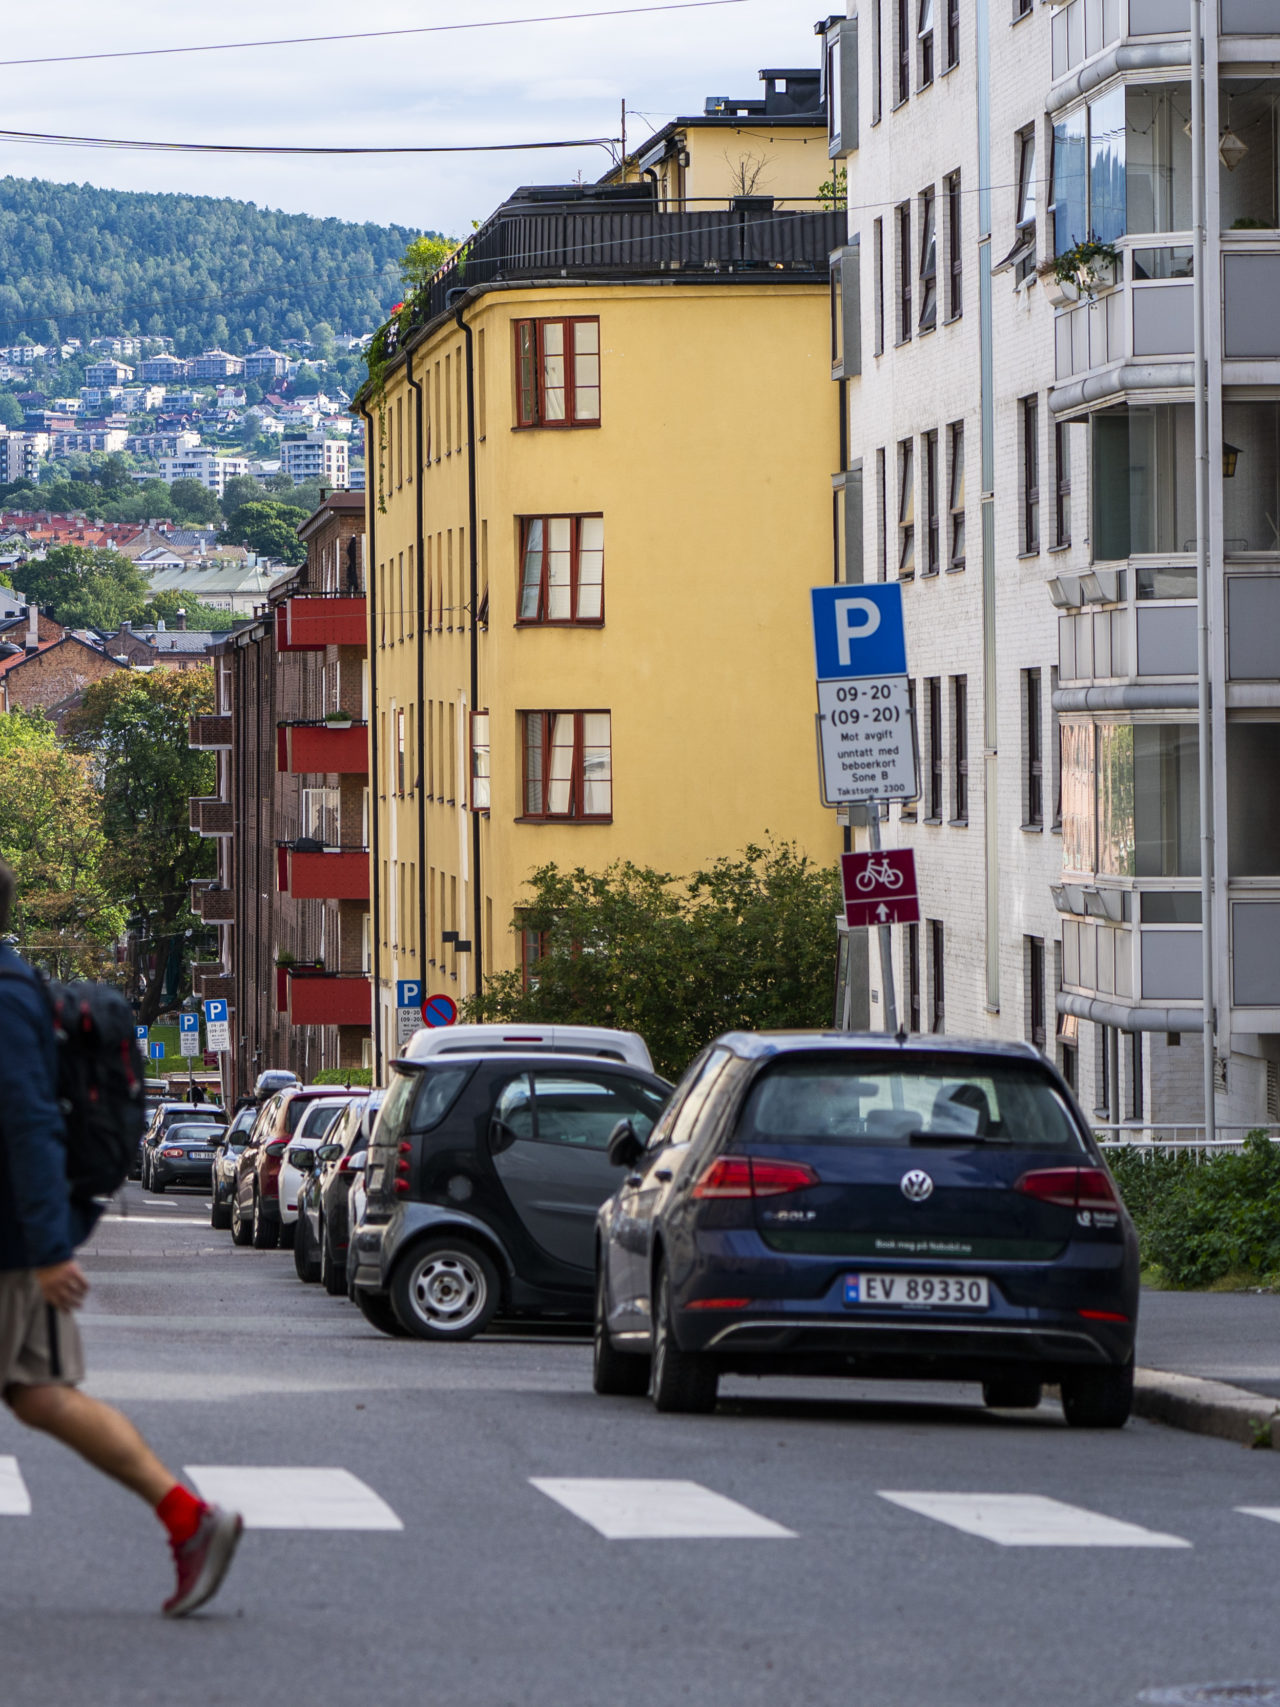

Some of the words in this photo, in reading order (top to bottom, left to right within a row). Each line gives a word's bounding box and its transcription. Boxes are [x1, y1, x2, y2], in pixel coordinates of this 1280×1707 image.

[835, 597, 881, 666] P
[841, 733, 859, 742] Mot
[864, 730, 893, 742] avgift
[838, 748, 874, 759] unntatt
[878, 746, 899, 756] med
[842, 759, 896, 771] beboerkort
[852, 773, 876, 783] Sone
[881, 771, 888, 780] B
[837, 785, 879, 796] Takstsone
[884, 784, 905, 793] 2300
[403, 983, 419, 1005] P
[210, 1002, 222, 1020] P
[184, 1016, 194, 1030] P
[137, 1027, 145, 1038] P
[866, 1277, 895, 1300] EV
[906, 1279, 981, 1303] 89330
